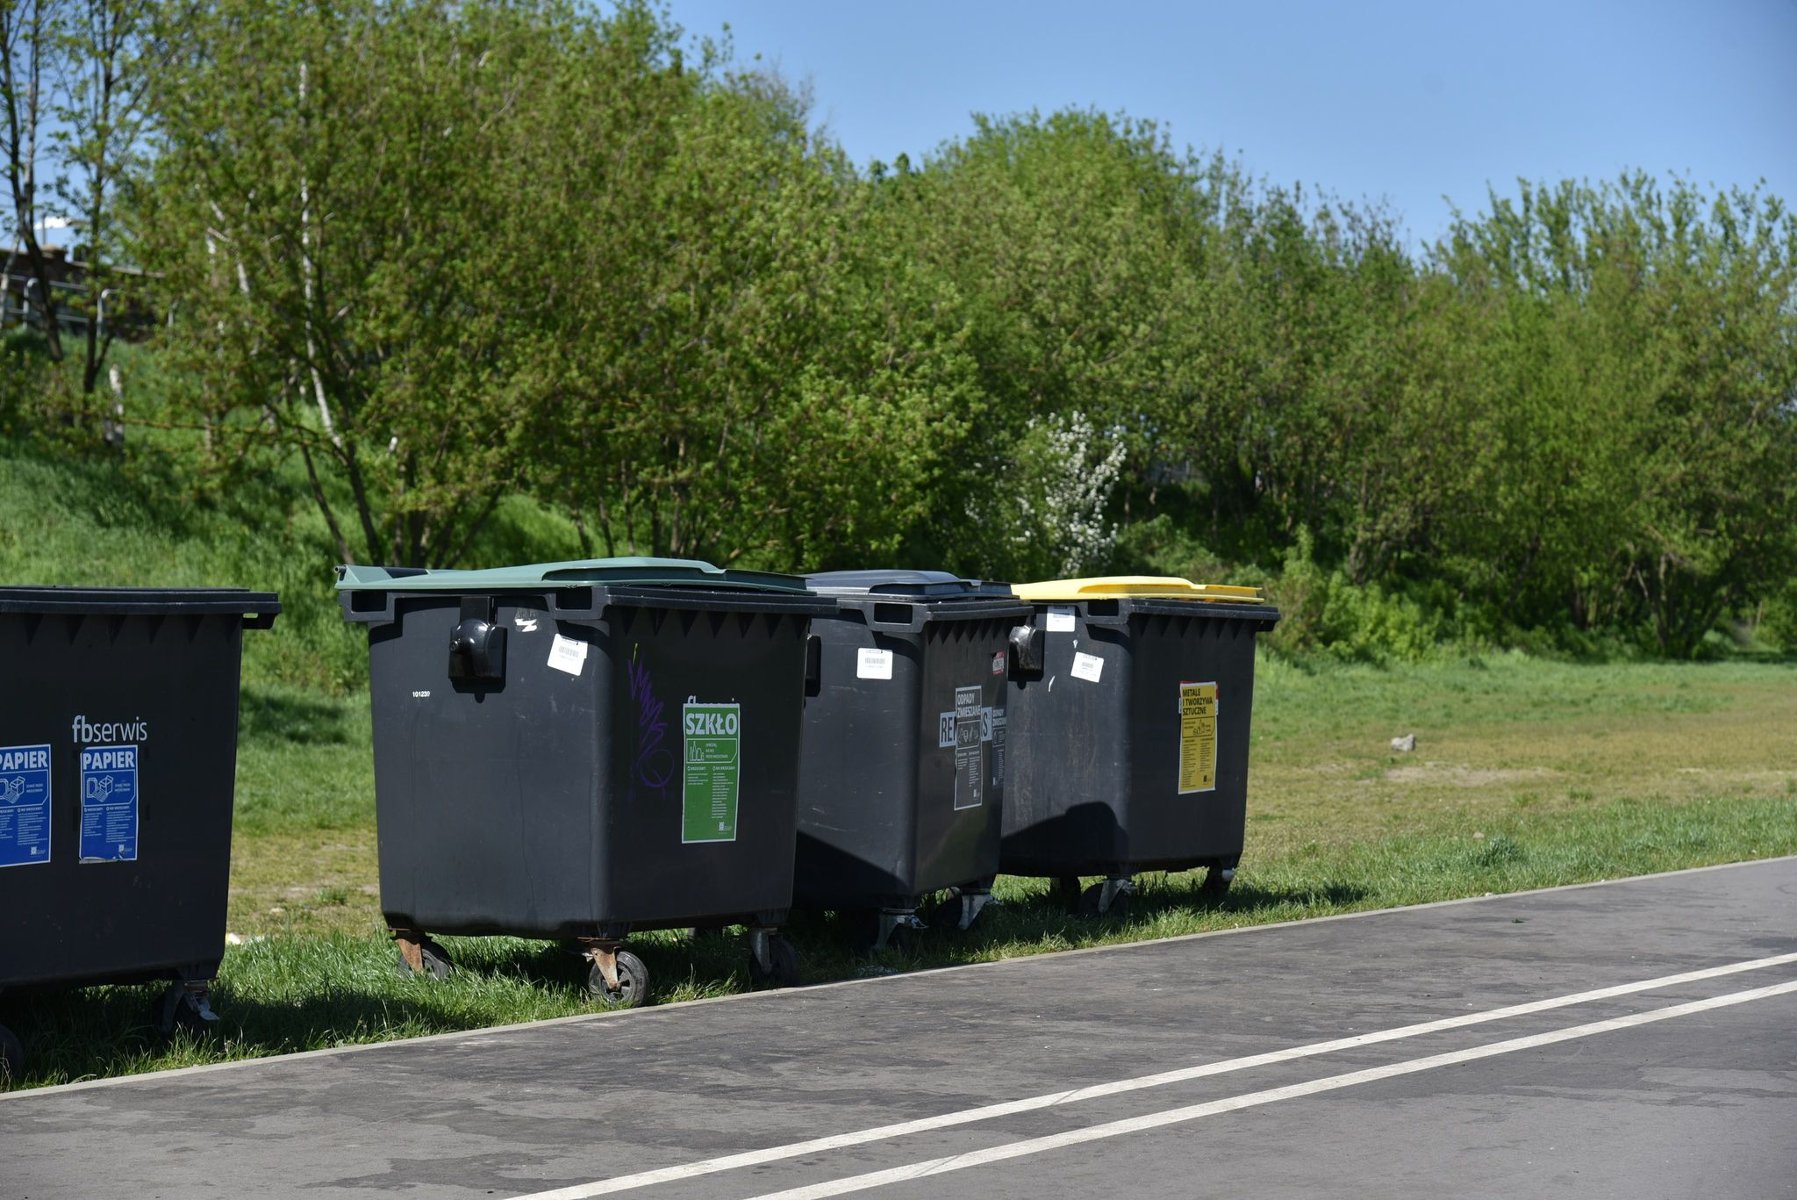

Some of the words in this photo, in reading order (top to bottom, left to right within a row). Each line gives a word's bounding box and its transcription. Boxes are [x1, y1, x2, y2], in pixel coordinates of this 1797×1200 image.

[72, 715, 148, 743] fbserwis
[685, 713, 738, 735] SZKŁO
[83, 751, 135, 770] PAPIER
